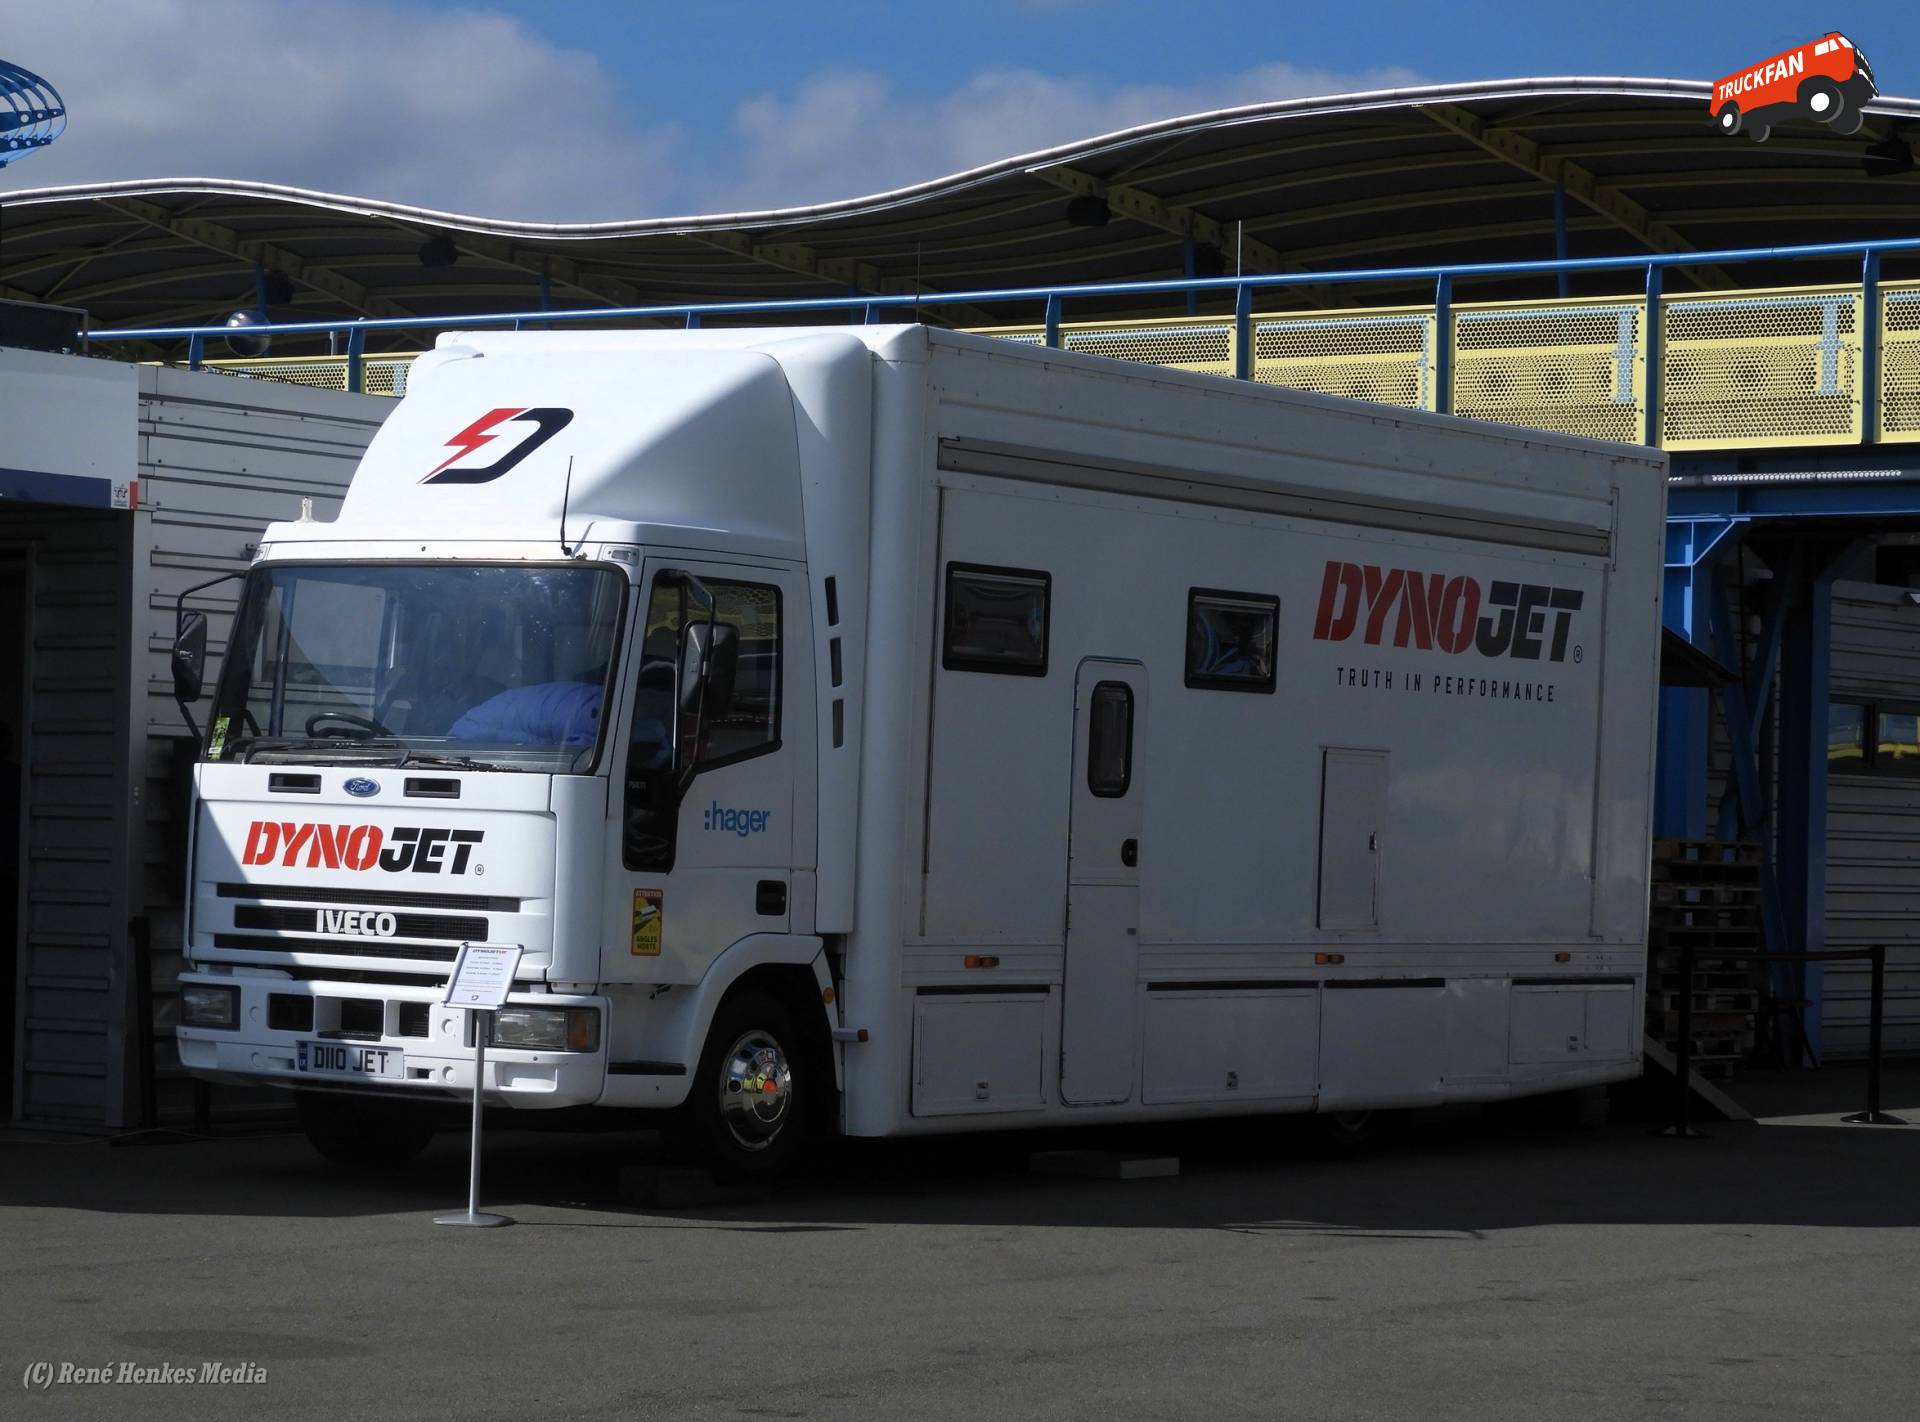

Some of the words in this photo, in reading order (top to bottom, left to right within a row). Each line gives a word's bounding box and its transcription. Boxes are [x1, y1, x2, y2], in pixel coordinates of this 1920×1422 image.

[1337, 667, 1393, 689] TRUTH
[1405, 673, 1421, 692] IN
[1434, 675, 1555, 702] PERFORMANCE
[316, 909, 397, 937] IVECO
[352, 1049, 389, 1074] JET
